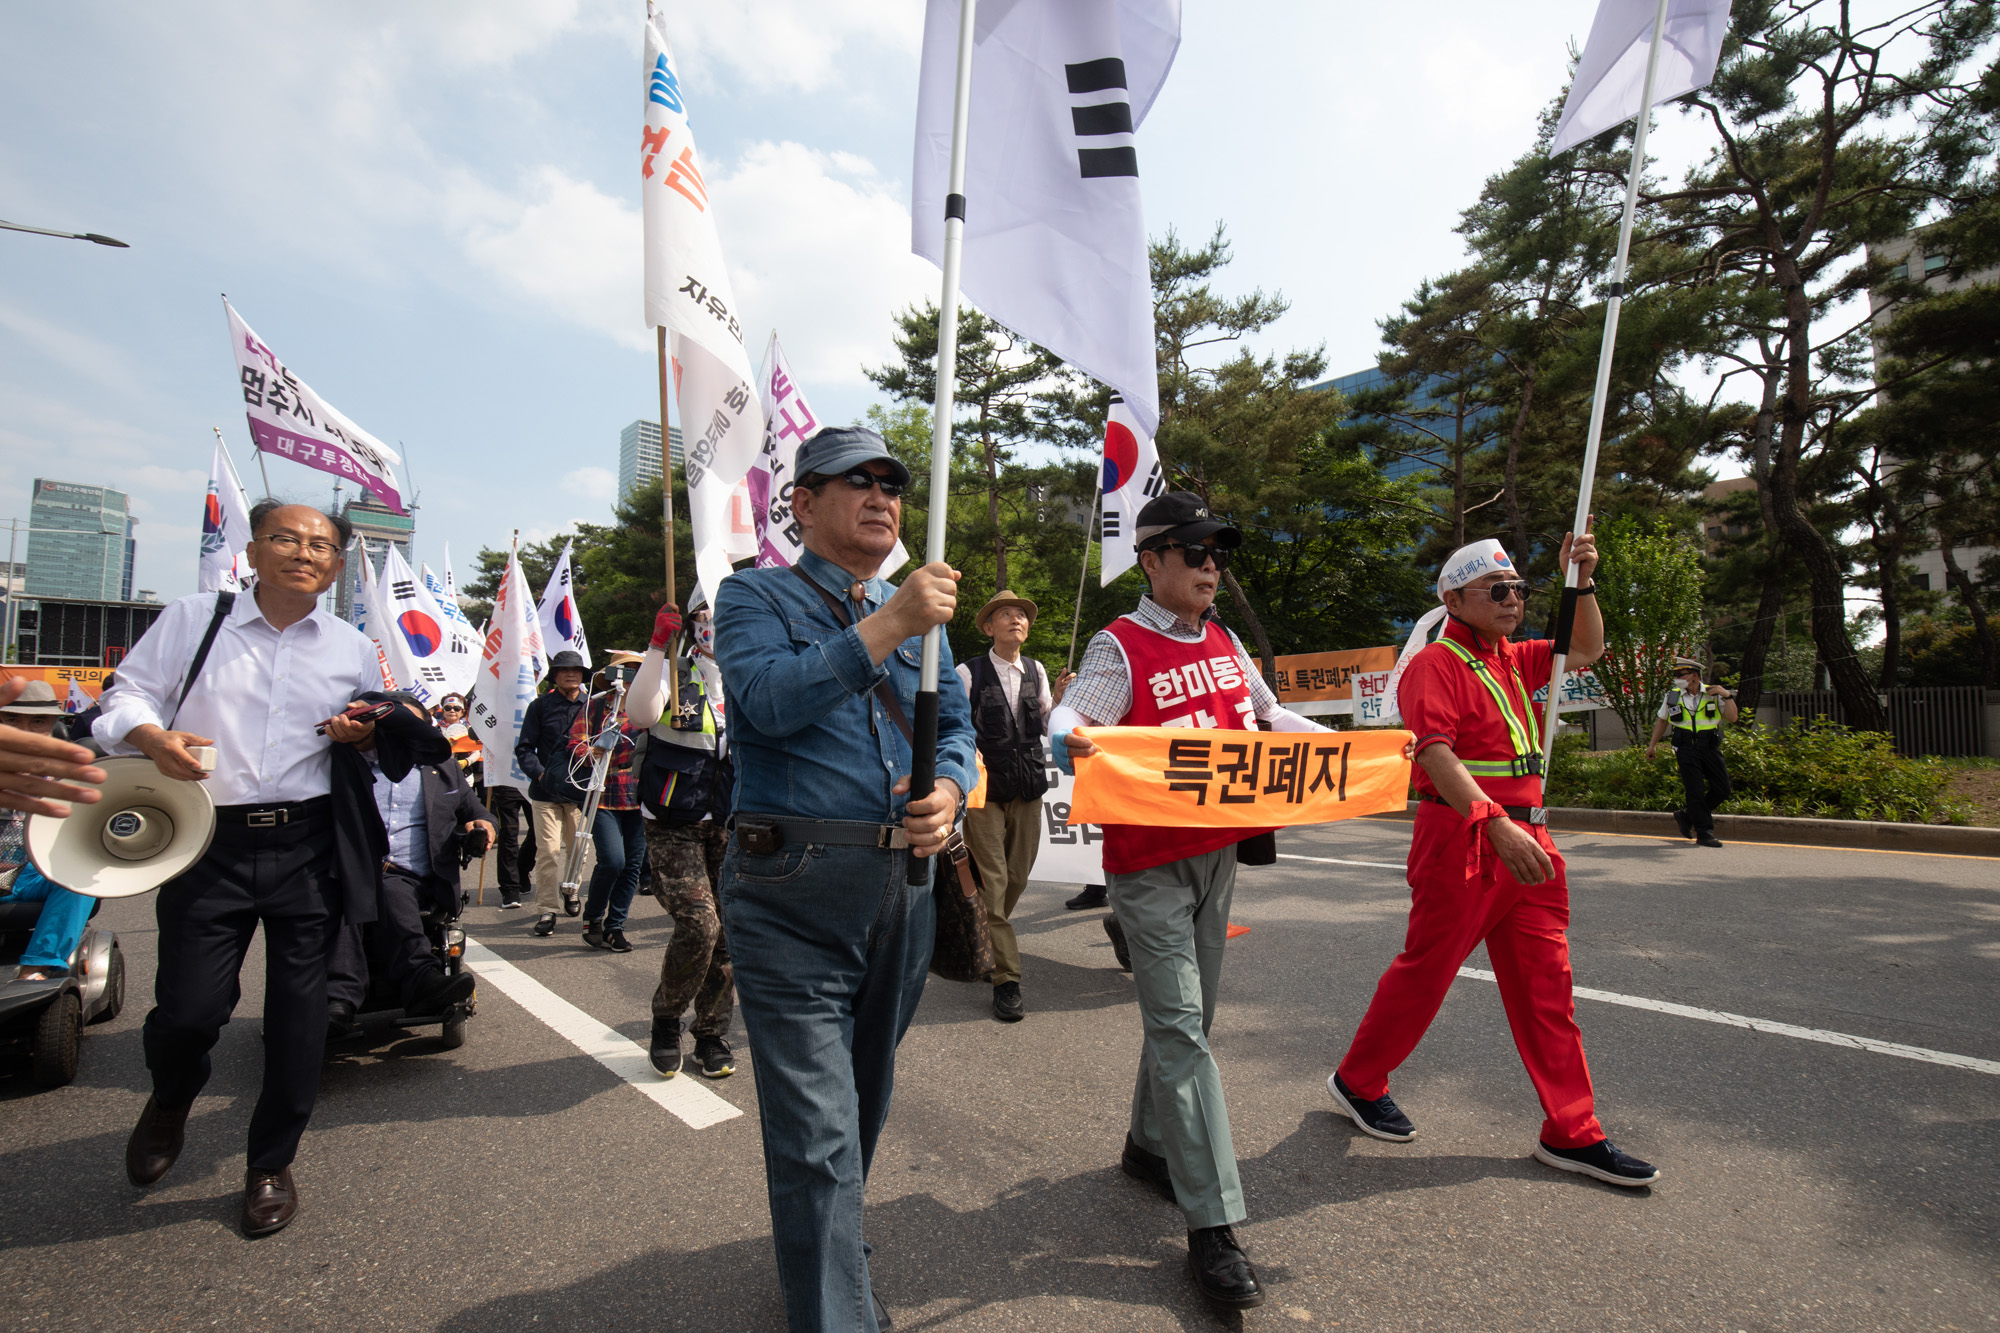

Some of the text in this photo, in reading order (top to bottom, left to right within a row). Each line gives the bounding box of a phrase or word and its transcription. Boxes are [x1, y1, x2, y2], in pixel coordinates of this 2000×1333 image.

[1447, 556, 1488, 585] 특권폐지
[56, 669, 103, 683] 국민의
[1163, 739, 1352, 806] 특권폐지
